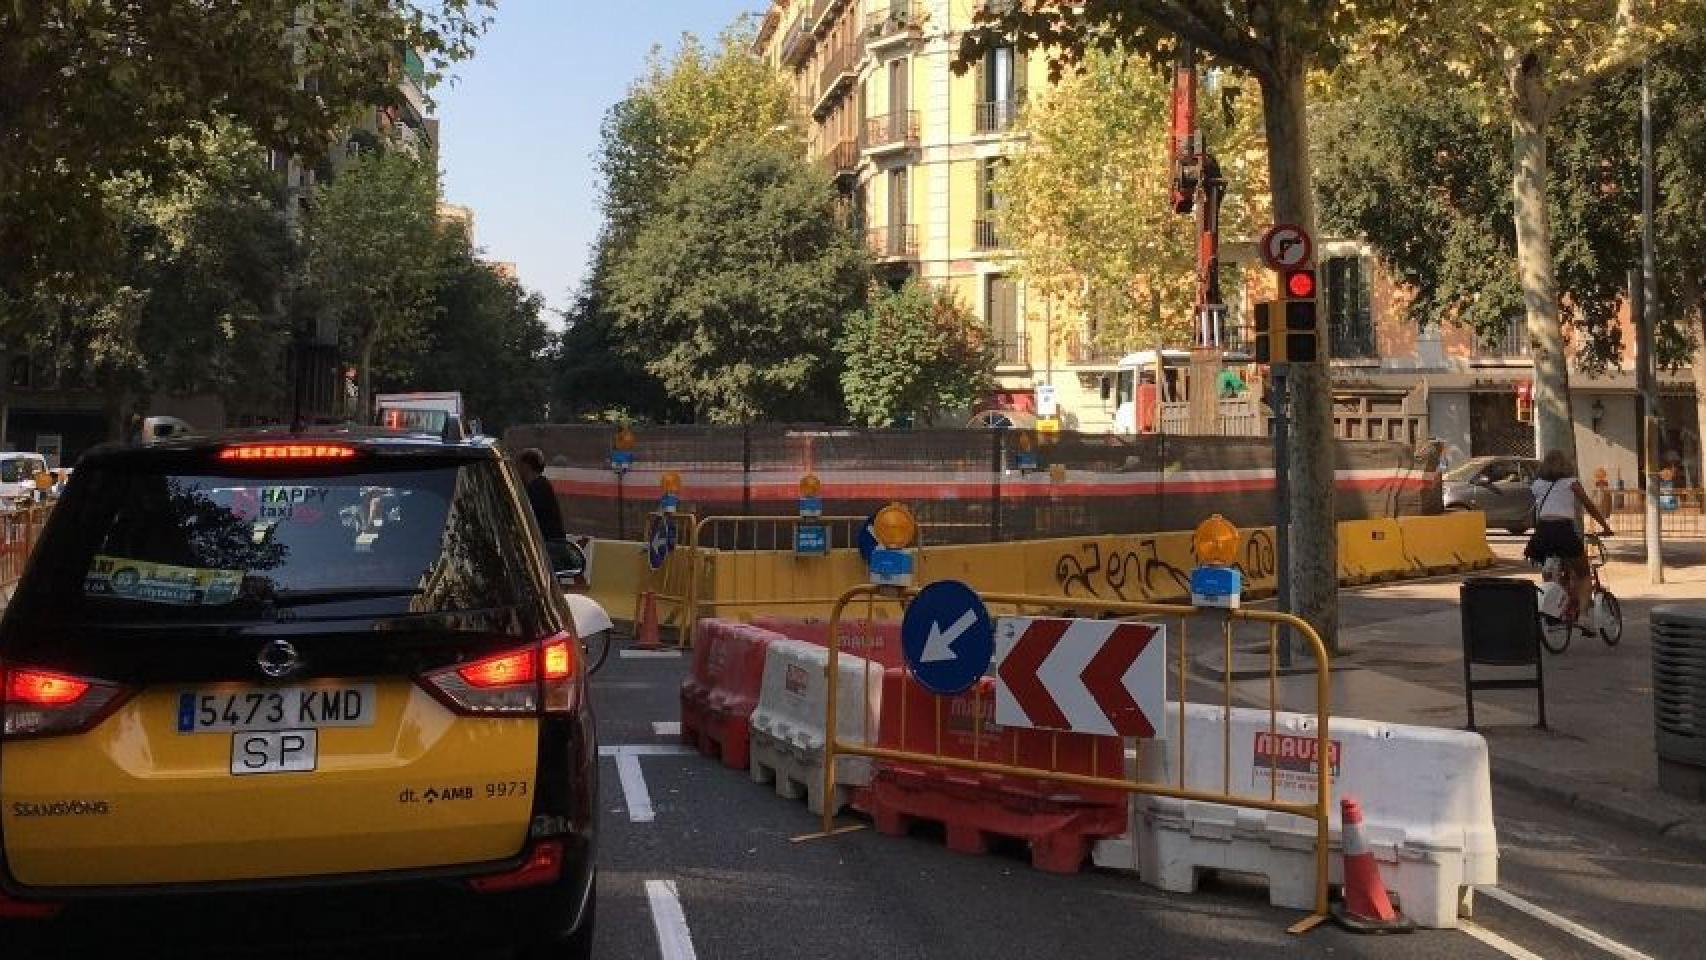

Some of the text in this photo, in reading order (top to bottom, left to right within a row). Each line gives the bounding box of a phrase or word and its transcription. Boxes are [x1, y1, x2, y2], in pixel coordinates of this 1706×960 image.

[262, 488, 328, 503] HAPPY
[200, 689, 362, 726] 5473 KMD
[399, 781, 528, 803] dt. AMB 9973
